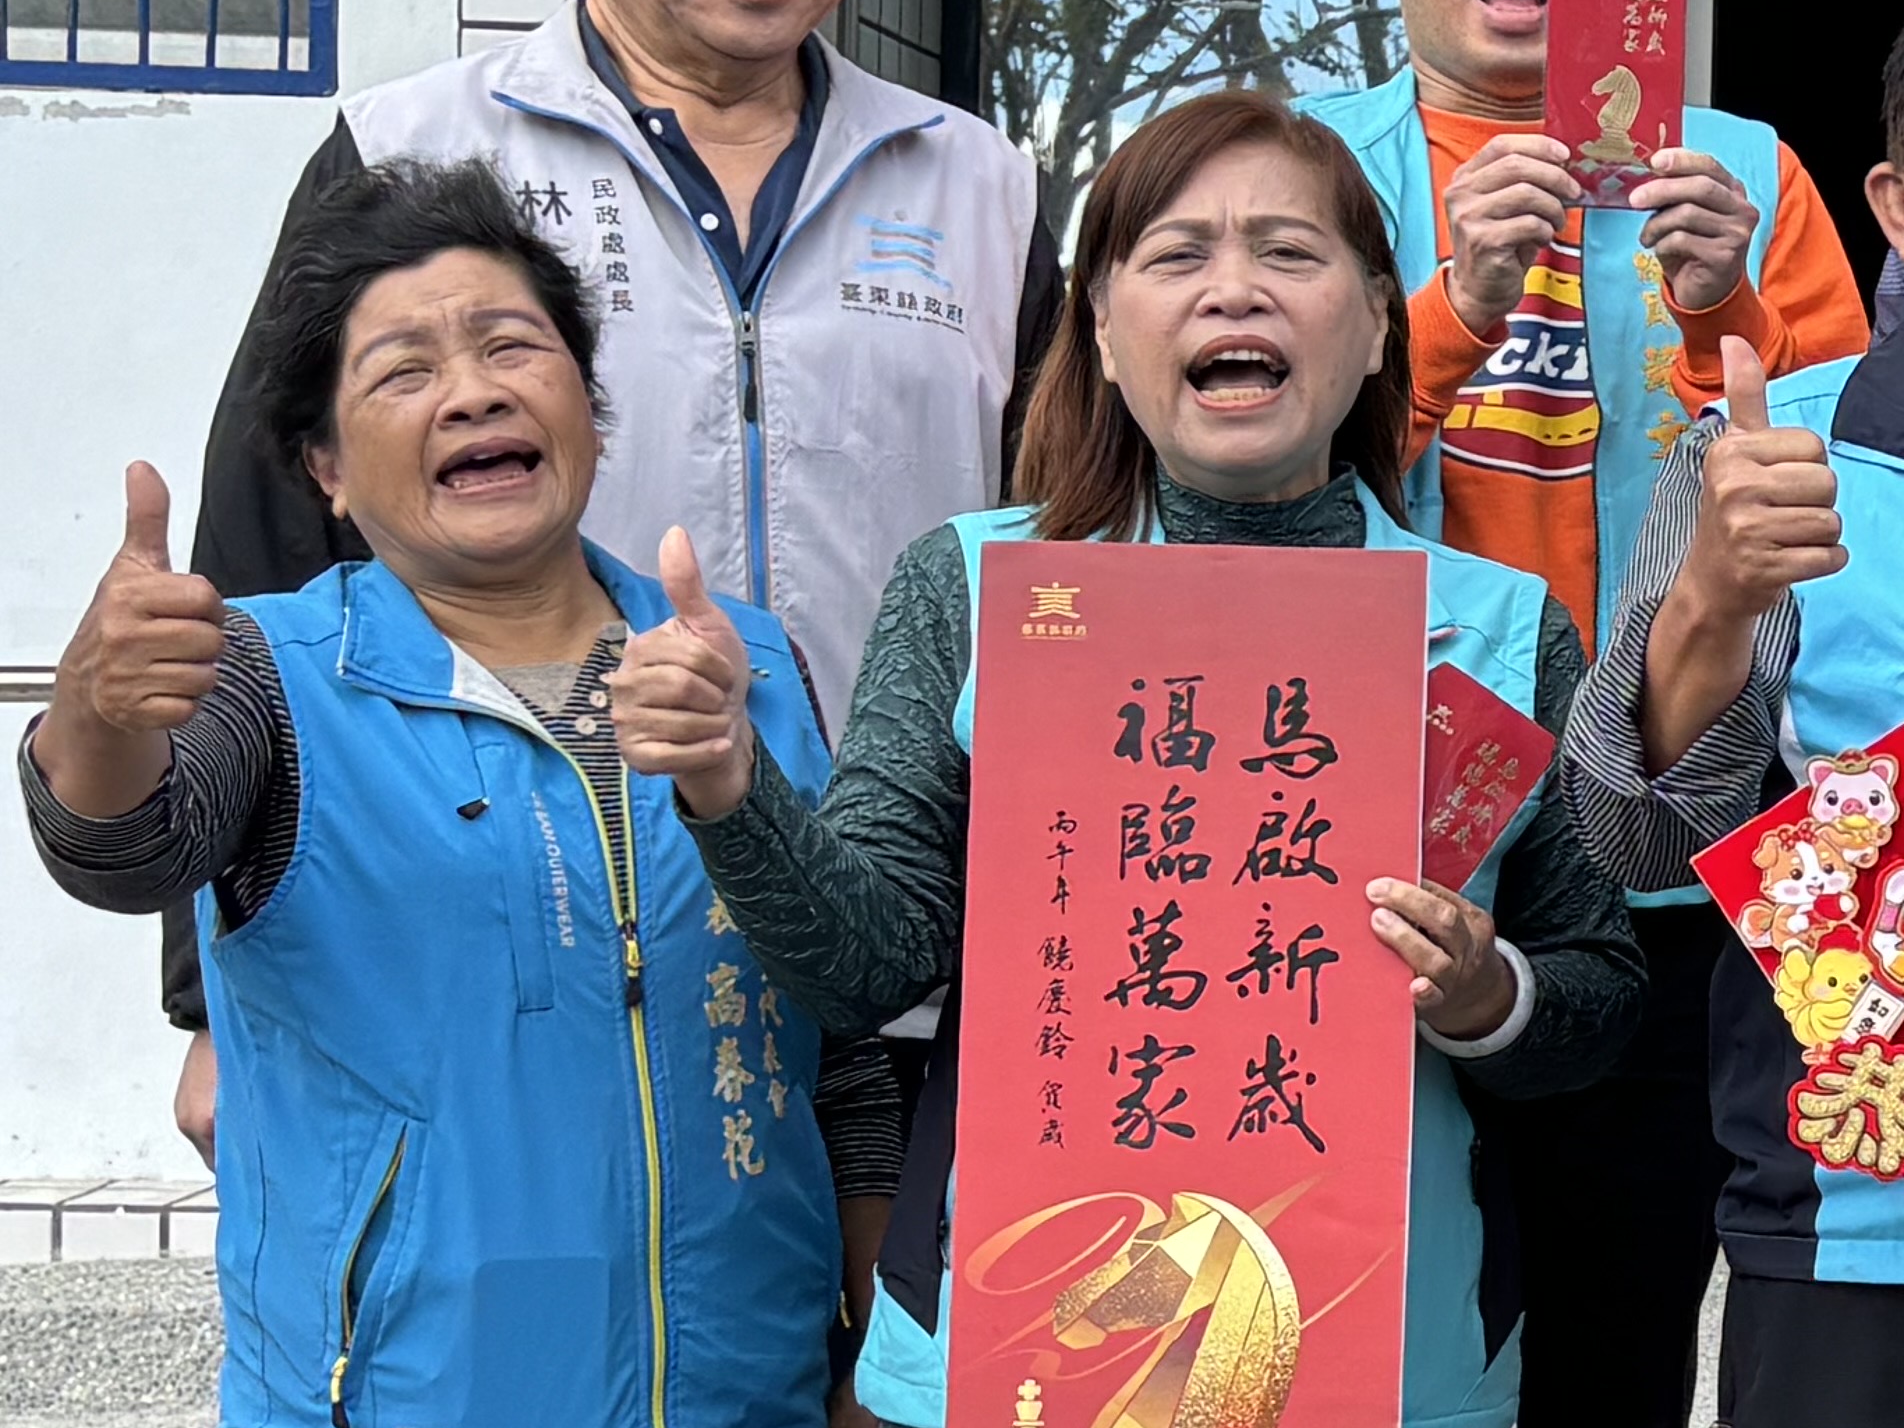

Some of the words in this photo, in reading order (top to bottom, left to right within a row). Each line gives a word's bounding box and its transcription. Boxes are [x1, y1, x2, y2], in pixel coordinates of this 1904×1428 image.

[516, 180, 572, 226] 林
[545, 844, 576, 949] OUTERWEAR
[1104, 674, 1216, 1150] 福臨萬家
